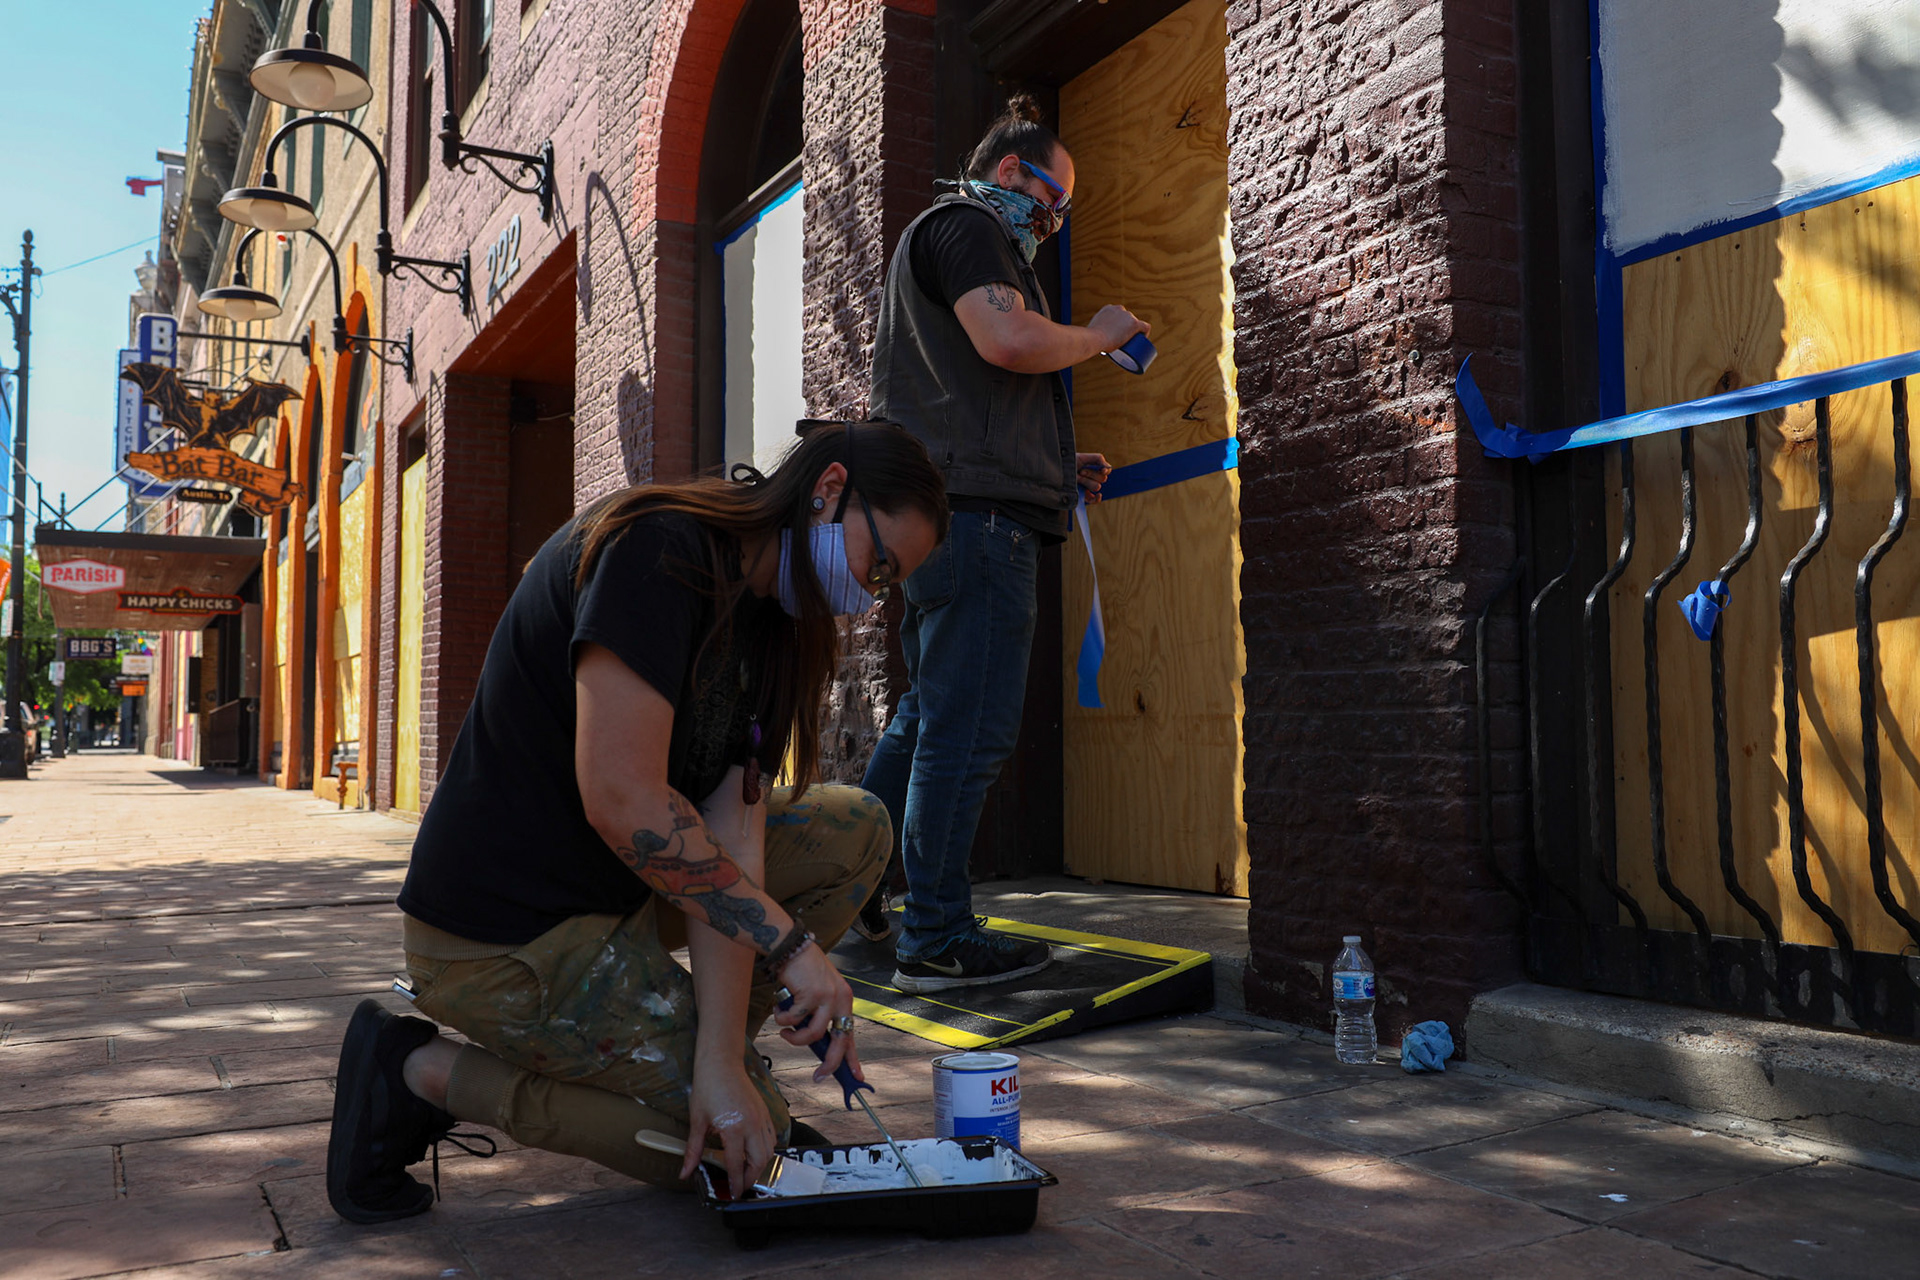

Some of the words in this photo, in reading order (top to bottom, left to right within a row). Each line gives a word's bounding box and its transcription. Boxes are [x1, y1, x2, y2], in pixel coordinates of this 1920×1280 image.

[486, 213, 521, 305] 222
[159, 453, 207, 475] Bat
[216, 456, 263, 487] Bar
[127, 596, 177, 608] HAPPY
[178, 597, 233, 610] CHICKS
[70, 639, 113, 653] BBG'S
